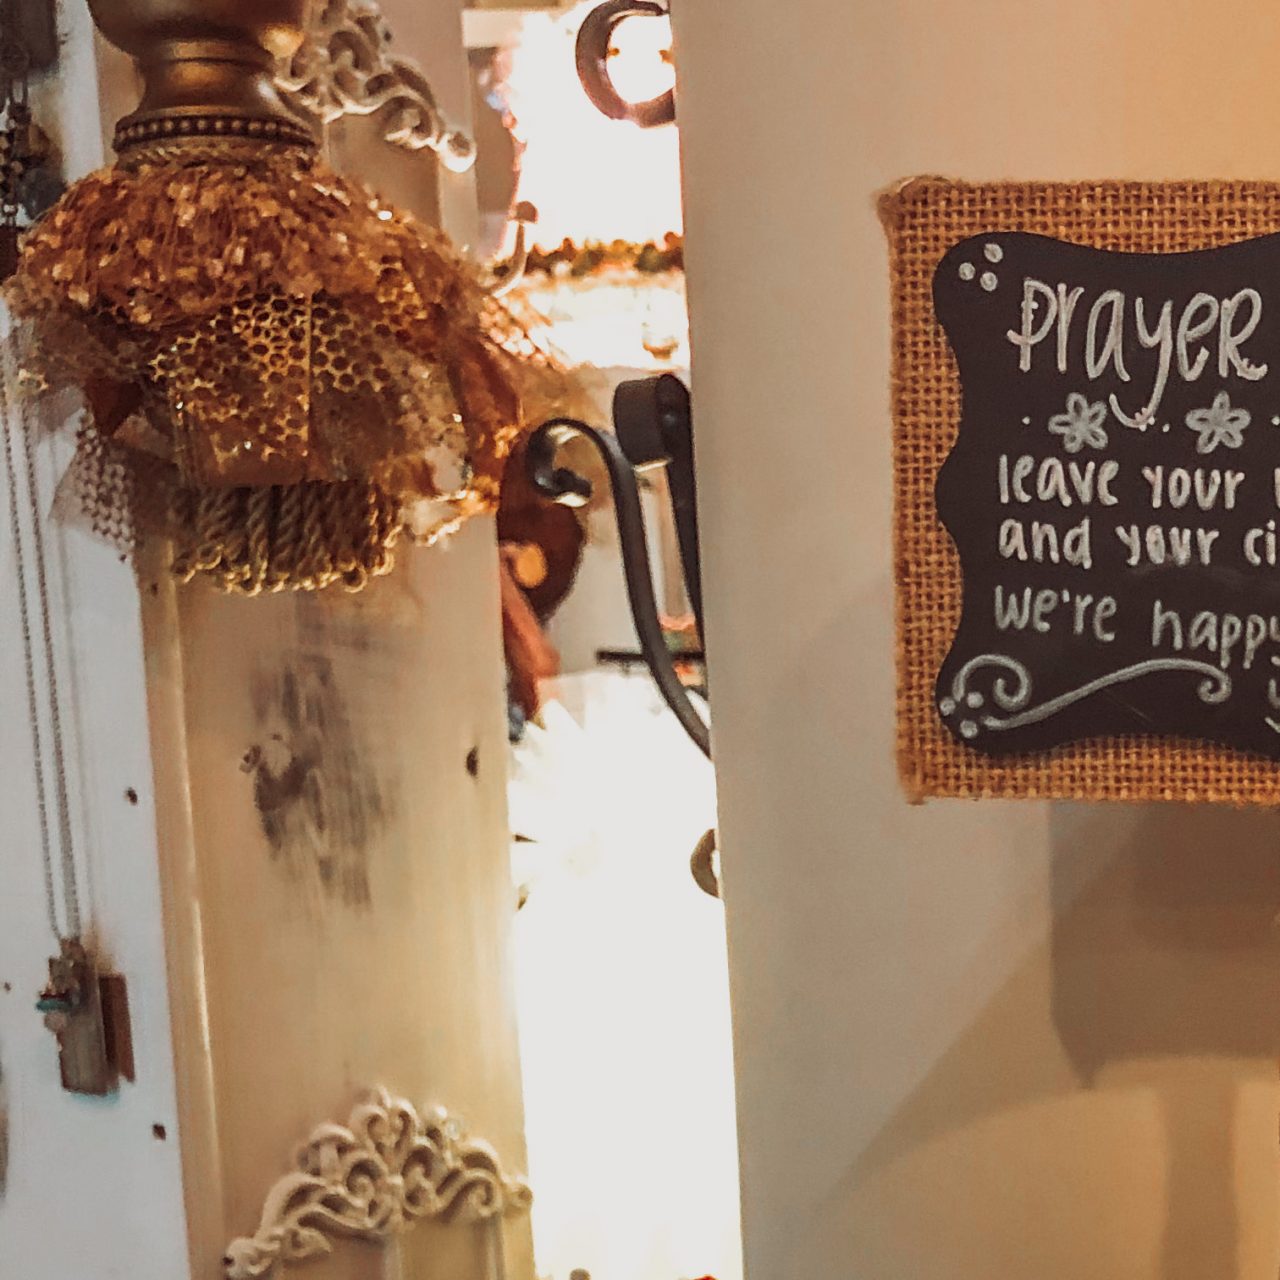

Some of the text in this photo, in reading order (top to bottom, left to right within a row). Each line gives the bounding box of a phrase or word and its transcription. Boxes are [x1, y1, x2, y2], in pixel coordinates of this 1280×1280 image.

[999, 452, 1119, 509] leave
[1142, 466, 1243, 511] your
[999, 518, 1092, 569] and
[1116, 525, 1219, 567] your
